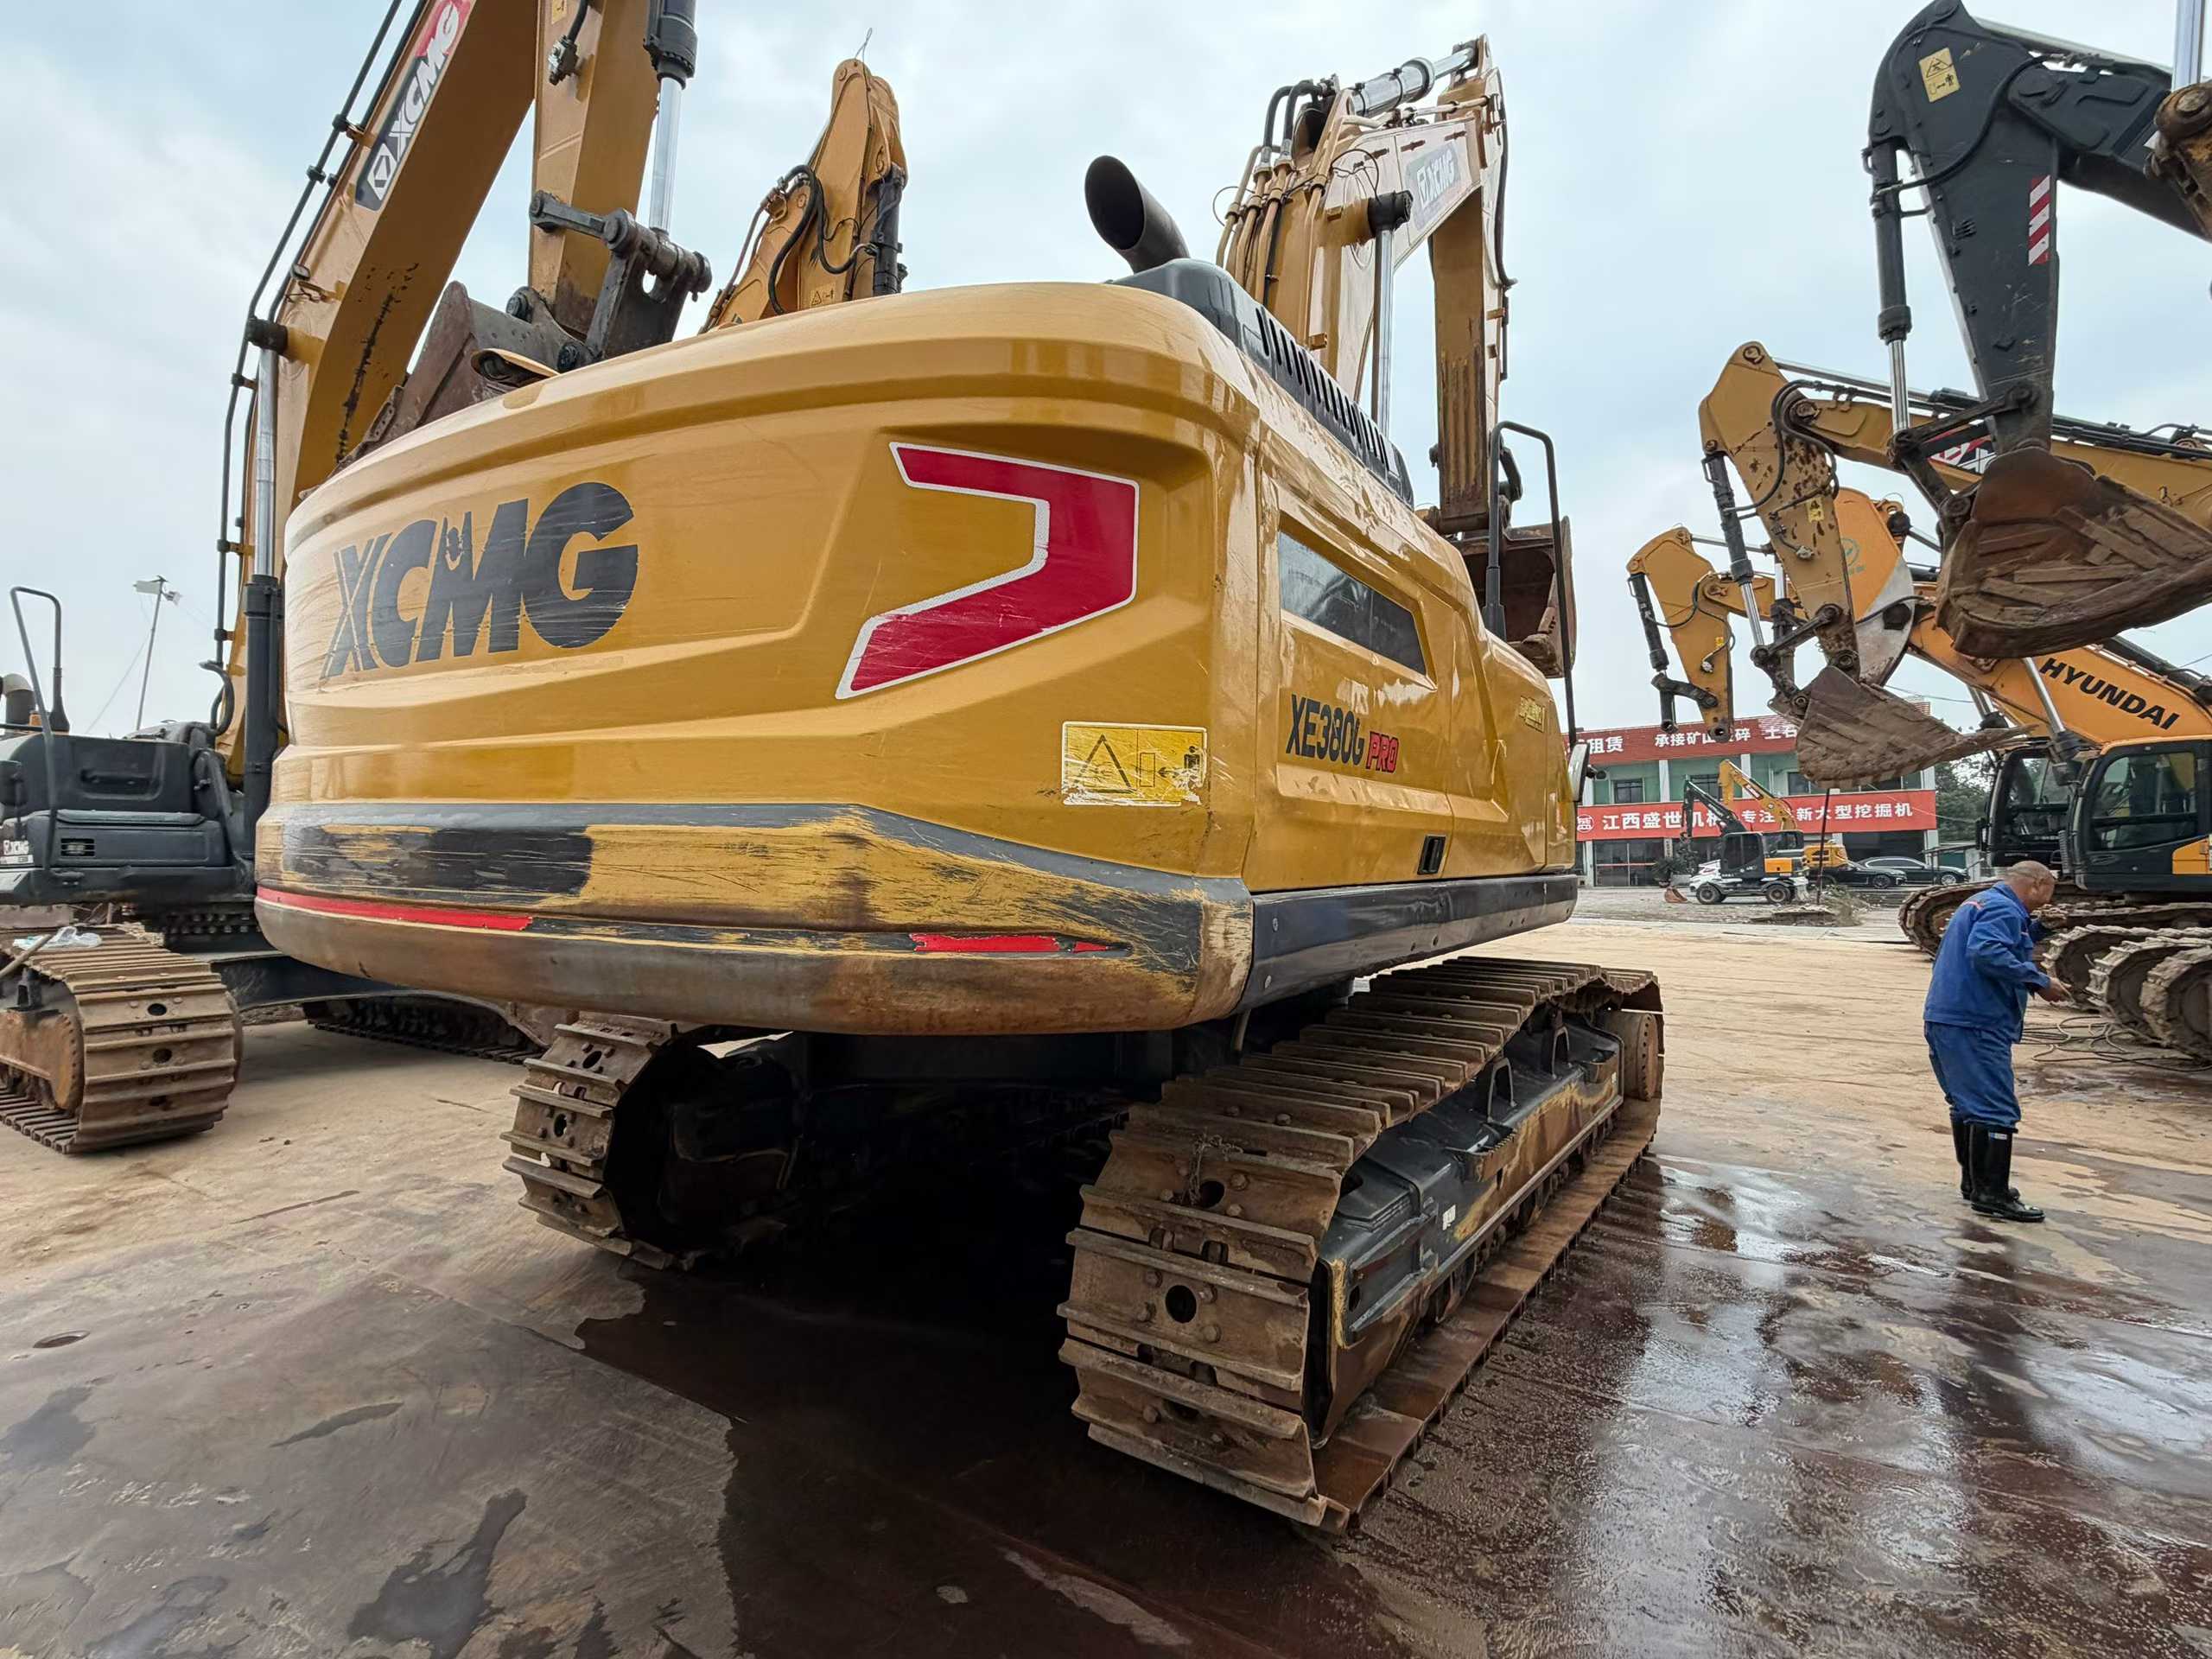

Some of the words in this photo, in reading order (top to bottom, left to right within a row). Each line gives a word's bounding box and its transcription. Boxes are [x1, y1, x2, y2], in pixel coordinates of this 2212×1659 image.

[387, 2, 460, 163] XCMG
[320, 481, 639, 678] XCMG
[2038, 657, 2181, 731] HYUNDAI
[1365, 730, 1400, 774] PRO
[1579, 735, 1624, 755] 租赁
[1654, 728, 1752, 748] 承接矿山碎
[1741, 802, 1913, 824] 专注新大型挖掘机
